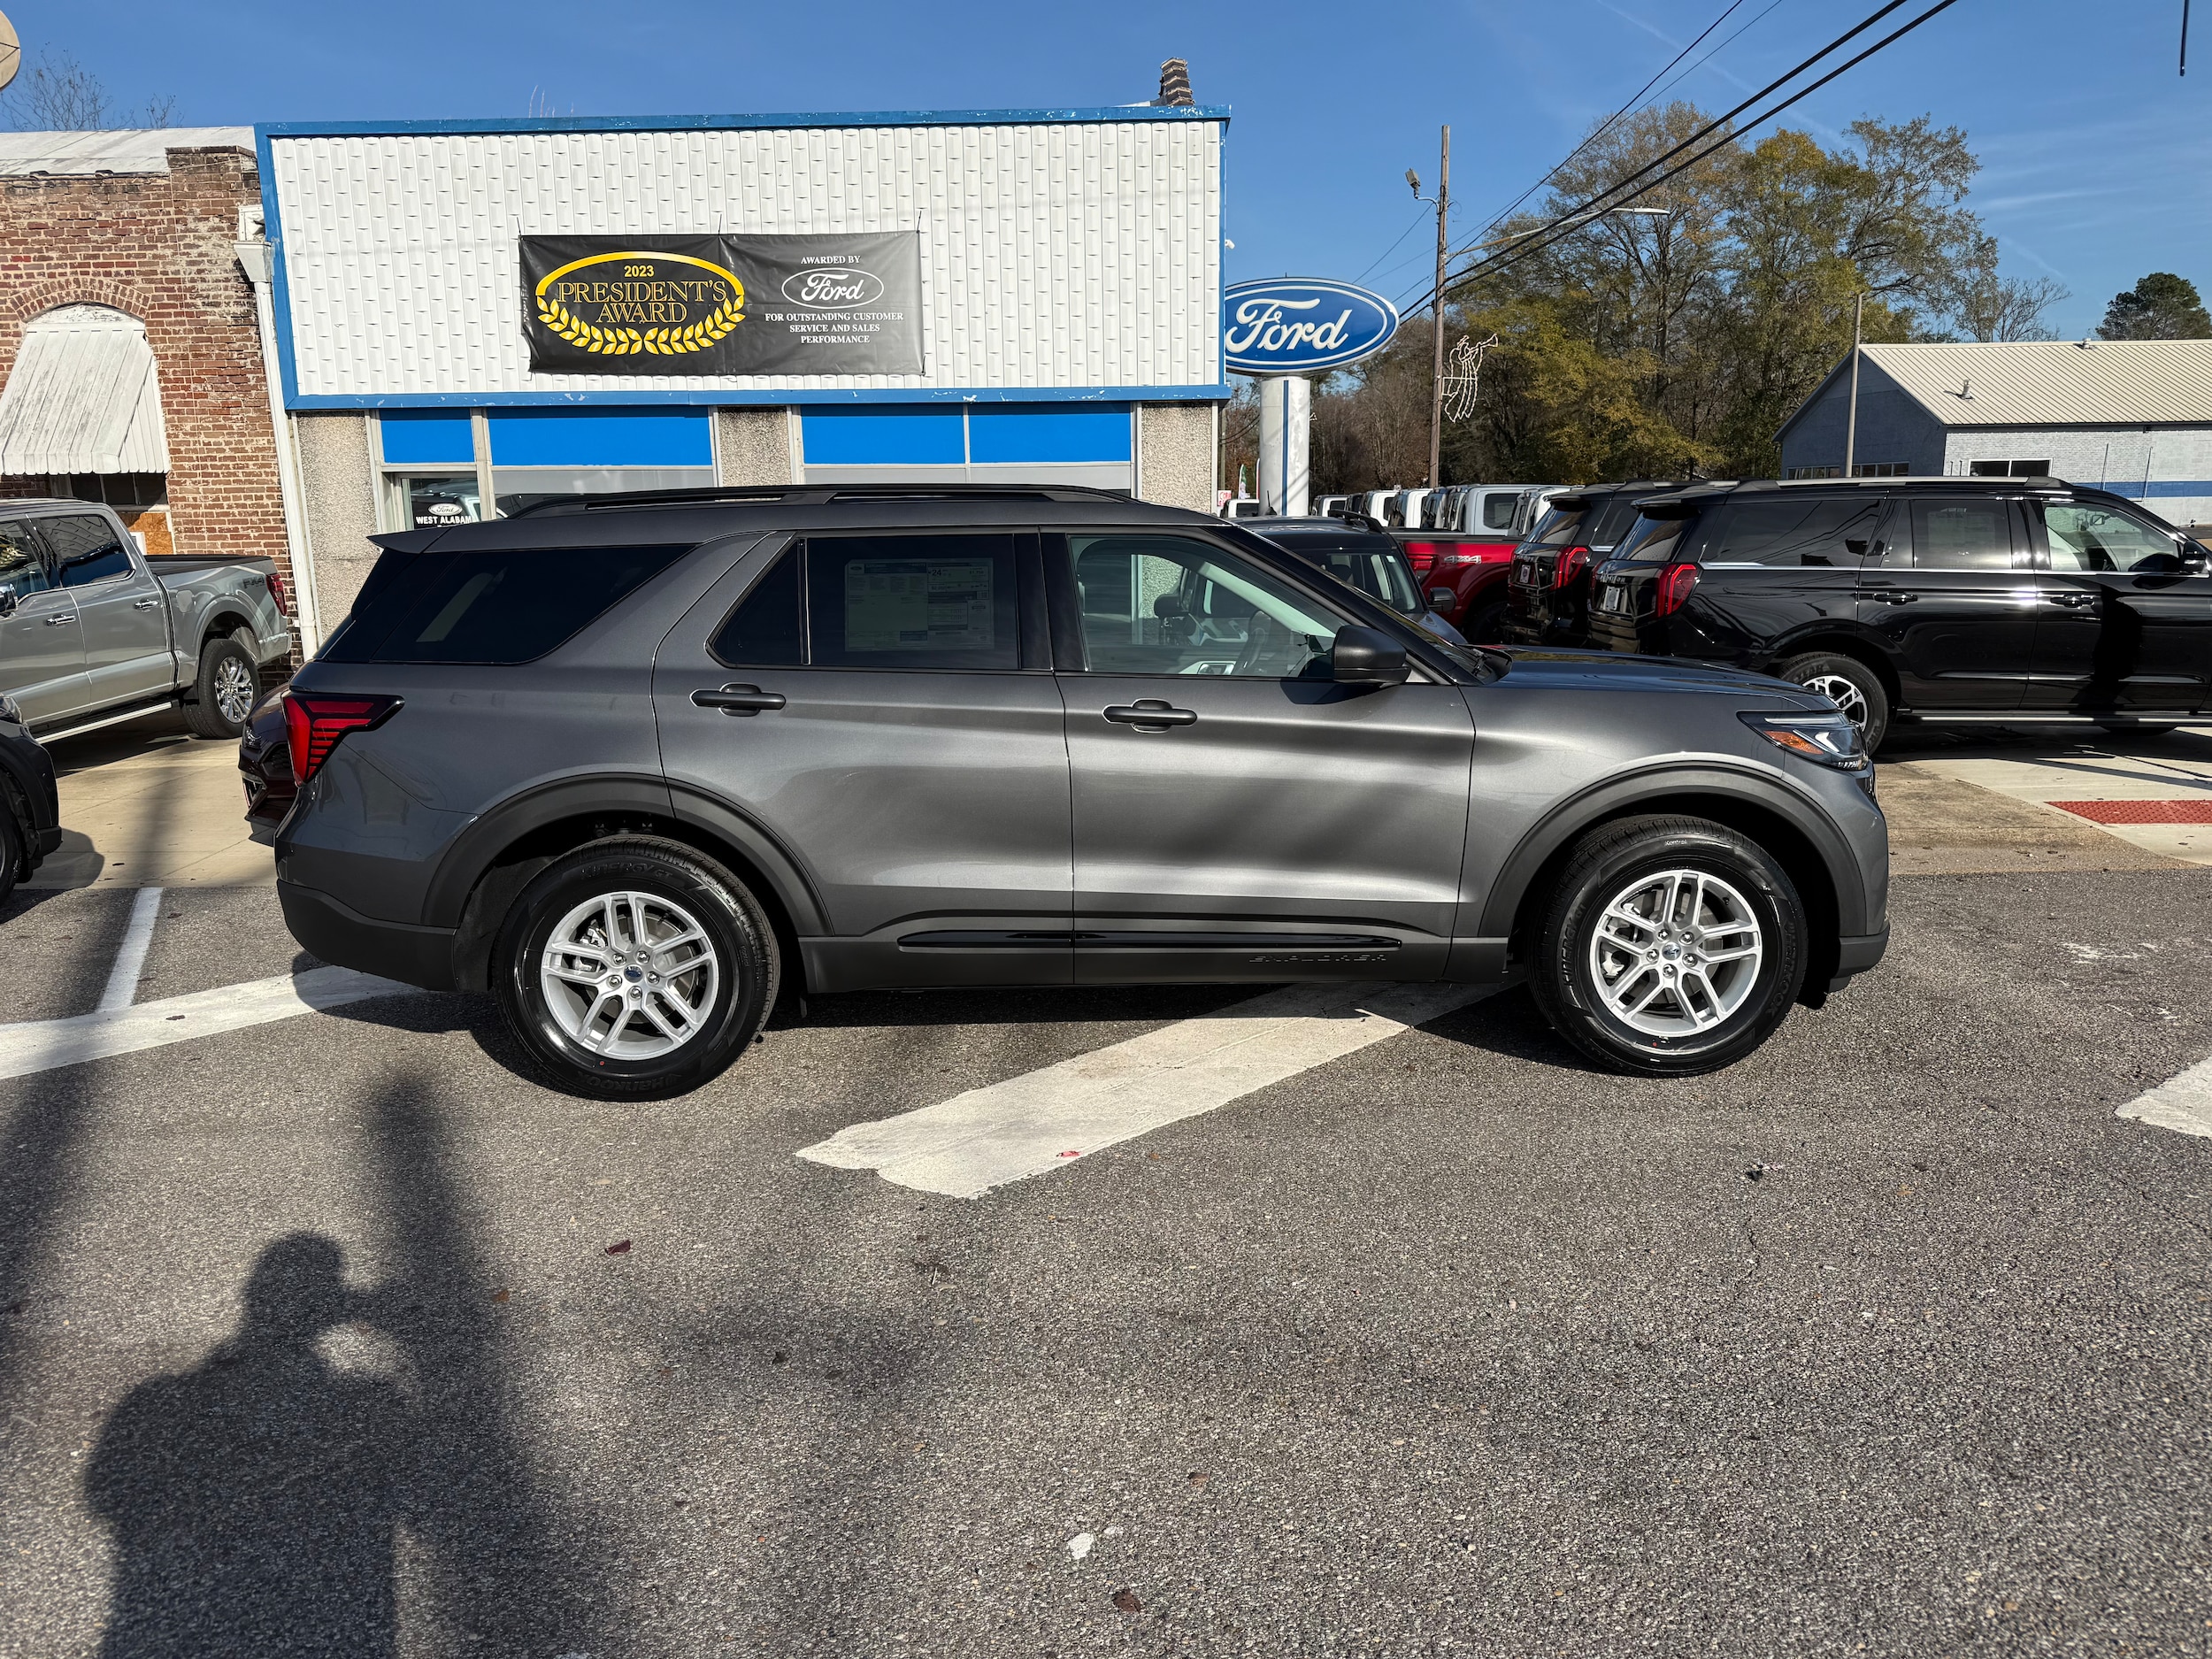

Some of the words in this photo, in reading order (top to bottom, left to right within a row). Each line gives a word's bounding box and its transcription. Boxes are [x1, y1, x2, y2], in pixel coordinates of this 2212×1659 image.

[801, 256, 846, 265] AWARDED
[624, 265, 655, 277] 2023
[557, 280, 726, 303] PRESIDENT'S
[801, 273, 865, 302] Ford
[595, 303, 688, 324] AWARD
[764, 313, 785, 322] FOR
[786, 312, 851, 321] OUTSTANDING
[853, 312, 904, 321] CUSTOMER
[831, 324, 850, 333] AND
[1225, 297, 1353, 353] Ford
[801, 335, 870, 344] PERFORMANCE
[415, 516, 438, 525] WEST
